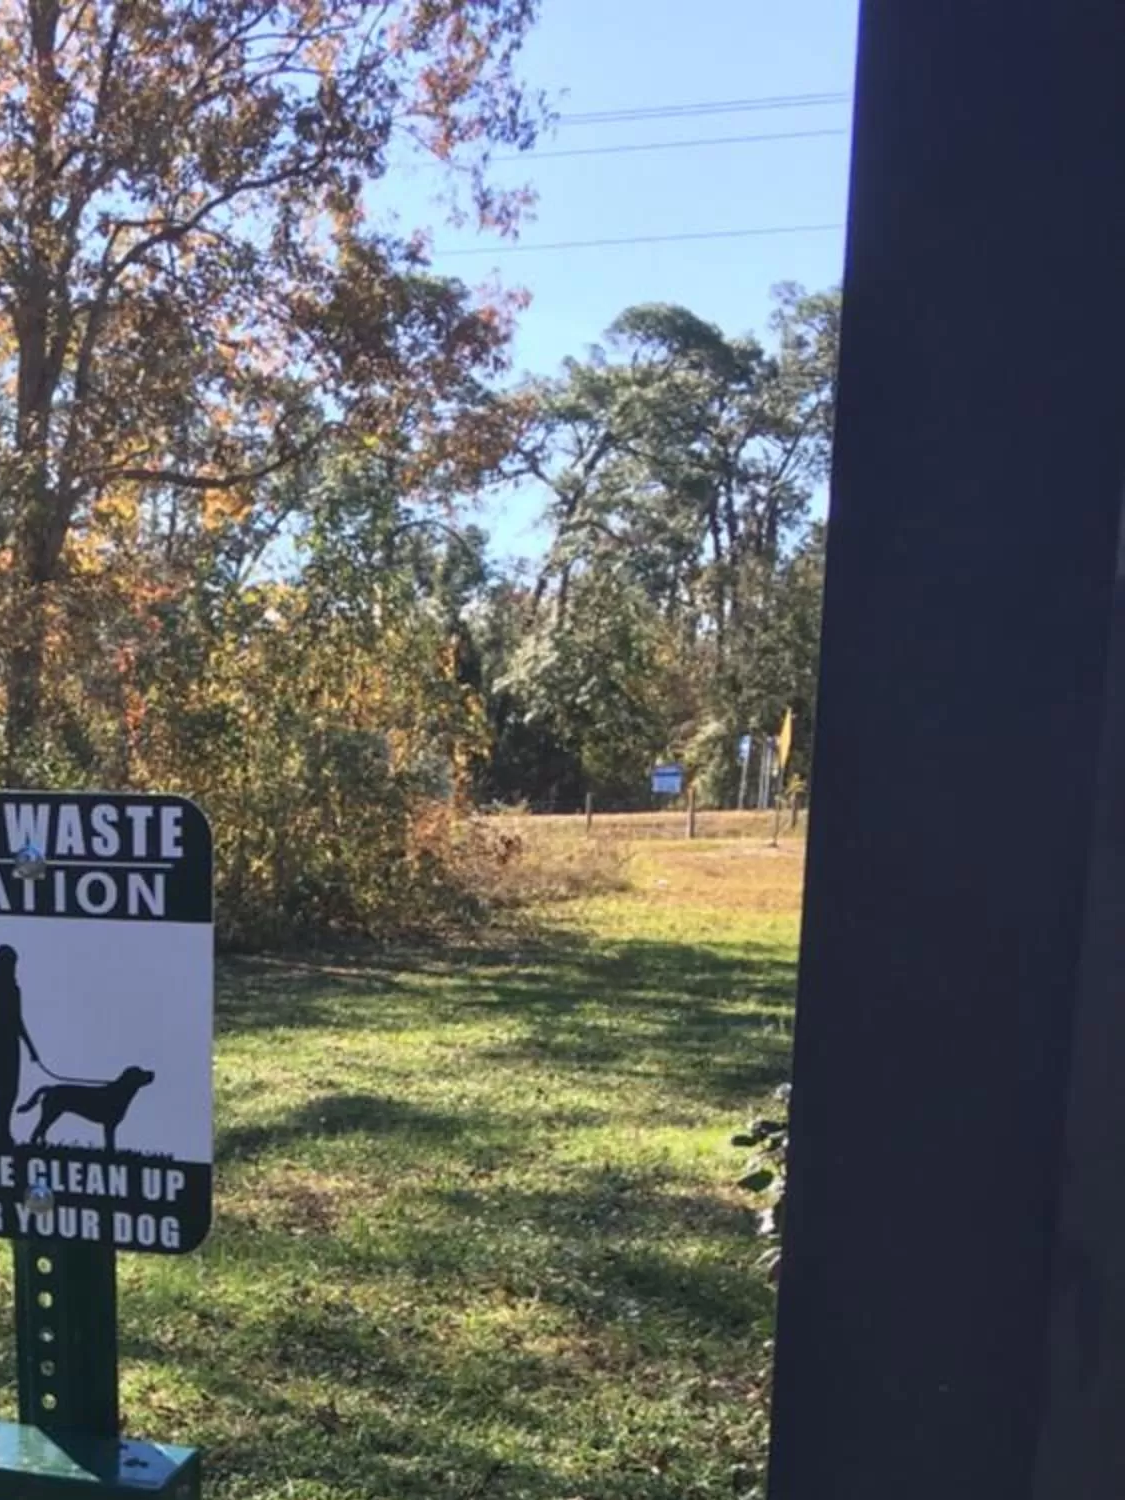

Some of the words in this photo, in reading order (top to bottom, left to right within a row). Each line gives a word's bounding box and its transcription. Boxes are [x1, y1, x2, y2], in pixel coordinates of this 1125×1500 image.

[4, 803, 184, 858] WASTE
[27, 1157, 127, 1197] CLEAN
[142, 1167, 185, 1202] UP
[15, 1202, 100, 1241] YOUR
[112, 1211, 180, 1249] DOG
